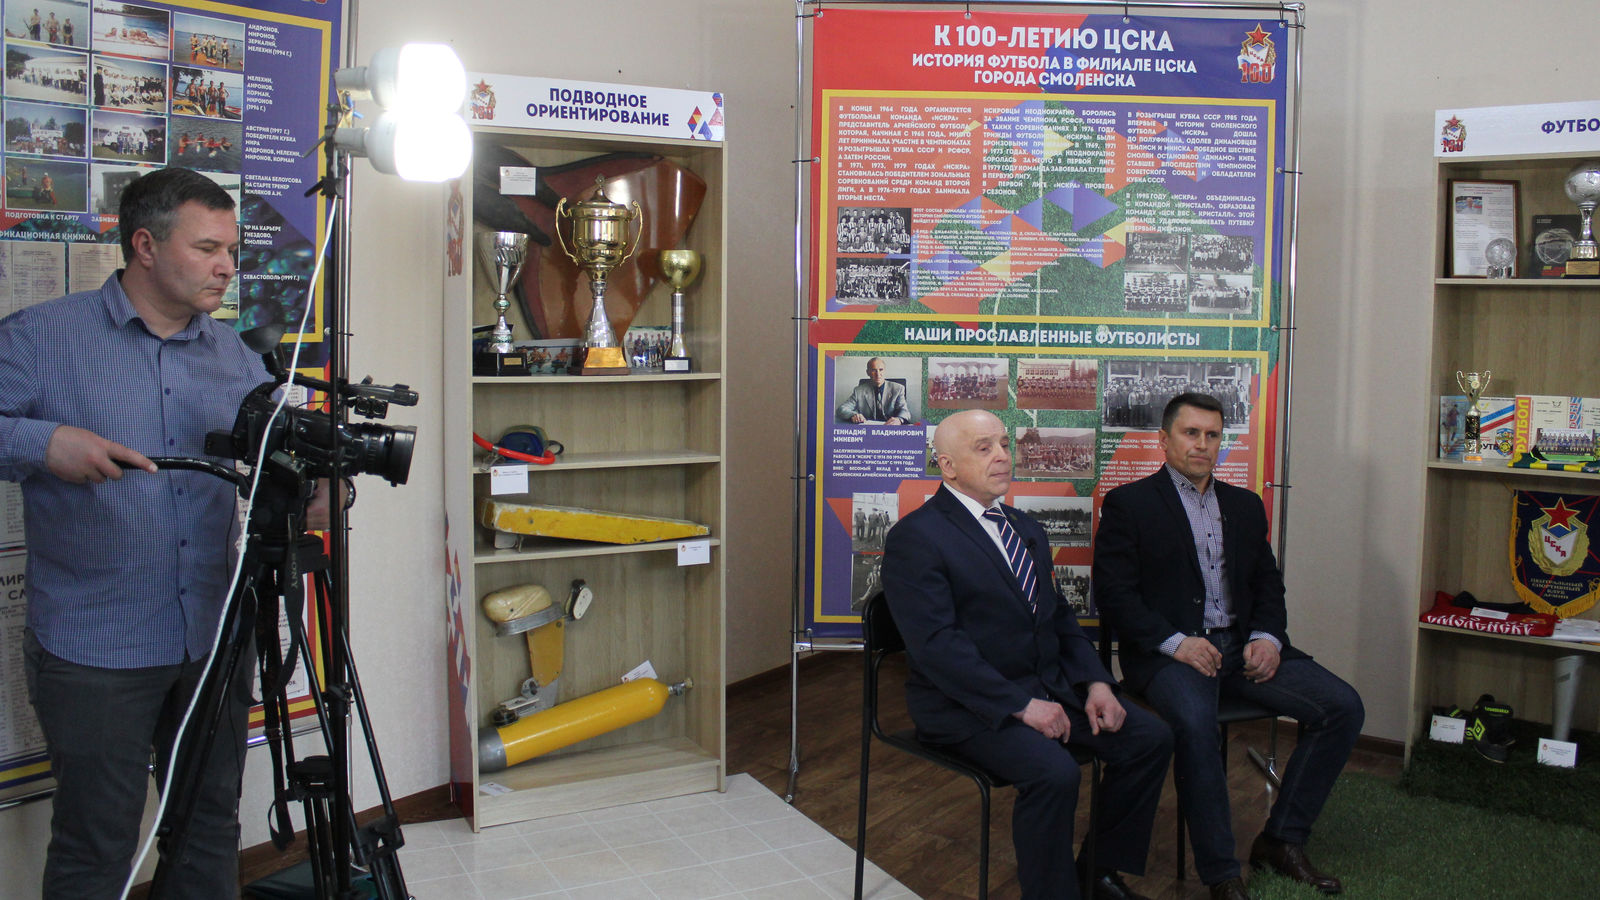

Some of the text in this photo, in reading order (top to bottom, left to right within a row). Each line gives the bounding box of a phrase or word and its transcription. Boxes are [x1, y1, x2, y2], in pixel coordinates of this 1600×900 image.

[934, 25, 1174, 54] К 100-ЛЕТИЮ ЦСКА
[912, 54, 1197, 74] ИСТОРИЯ ФУТБОЛА В ФИЛИАЛЕ ЦСКА
[974, 70, 1136, 87] ГОРОДА СМОЛЕНСКА
[550, 88, 647, 108] ПОДВОДНОЕ
[526, 104, 670, 126] ОРИЕНТИРОВАНИЕ
[1541, 118, 1600, 134] ФУТБО
[904, 327, 1200, 346] НАШИ ПРОСЛАВЛЕННЫЕ ФУТБОЛИСТЫ
[833, 428, 866, 436] ГЕННАДИЙ
[1544, 536, 1566, 558] ЦСКА
